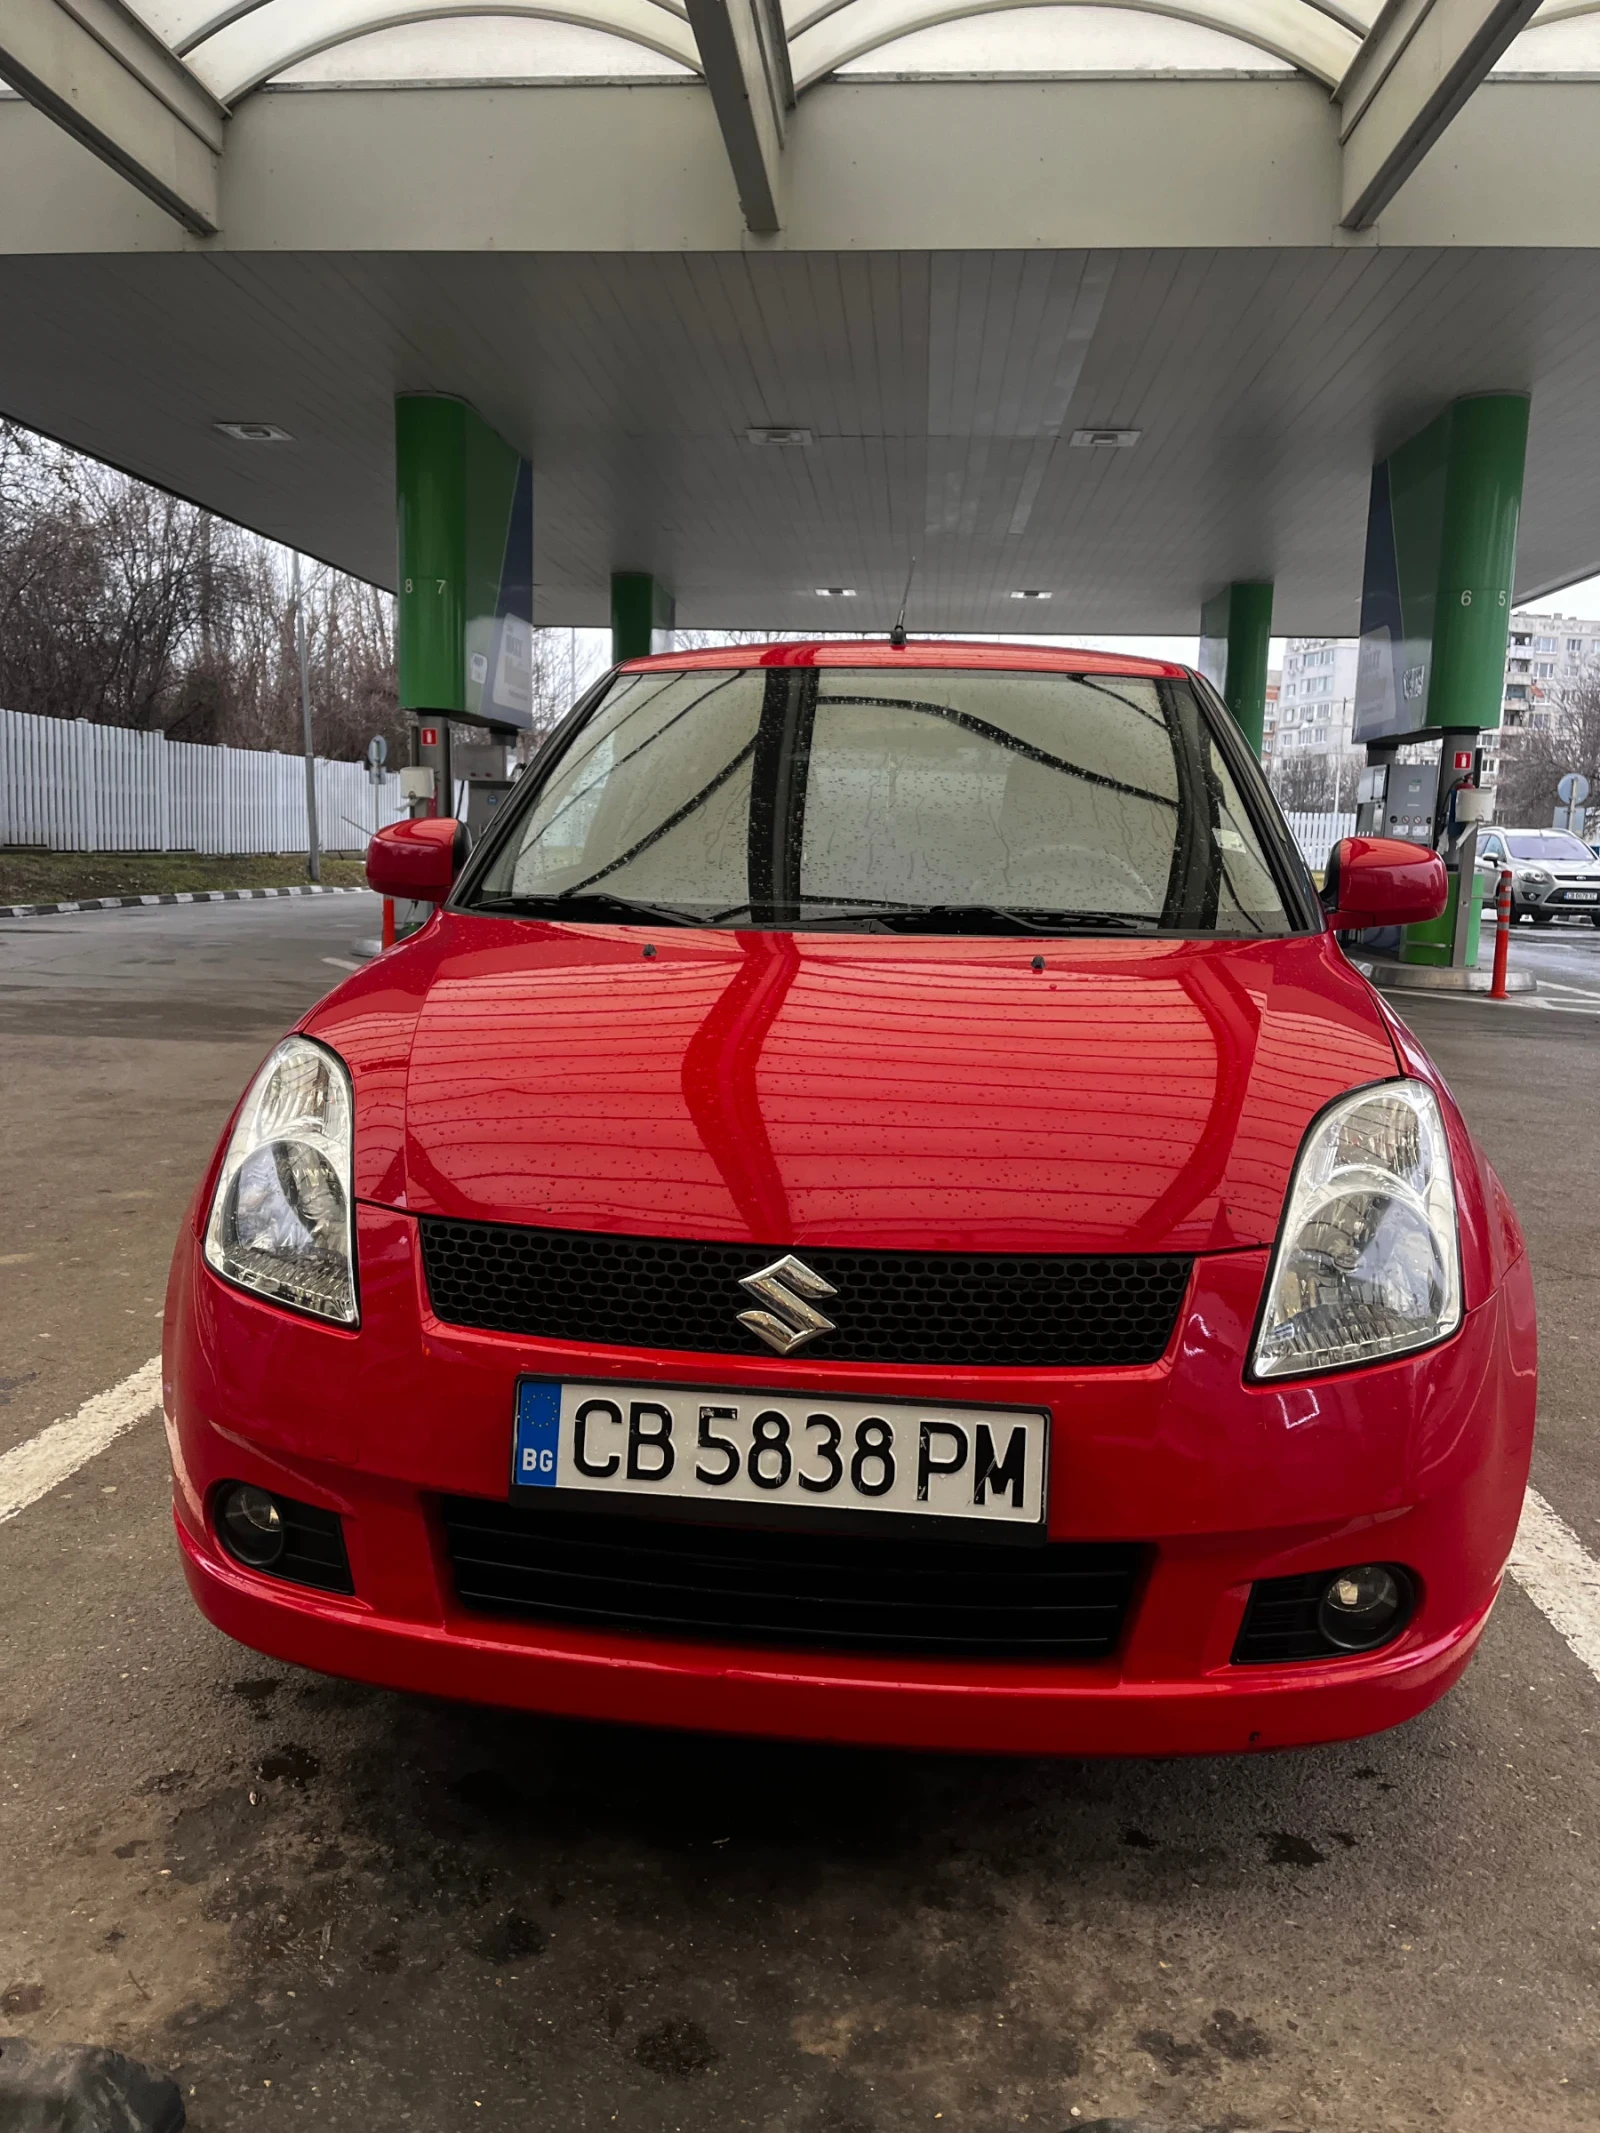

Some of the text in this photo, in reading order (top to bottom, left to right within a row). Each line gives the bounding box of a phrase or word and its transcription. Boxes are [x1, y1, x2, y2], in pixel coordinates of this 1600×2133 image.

[405, 578, 445, 594] 8 7
[1461, 589, 1506, 606] 6 5
[521, 1448, 554, 1472] BG
[573, 1398, 1027, 1508] CB 5838 PM
